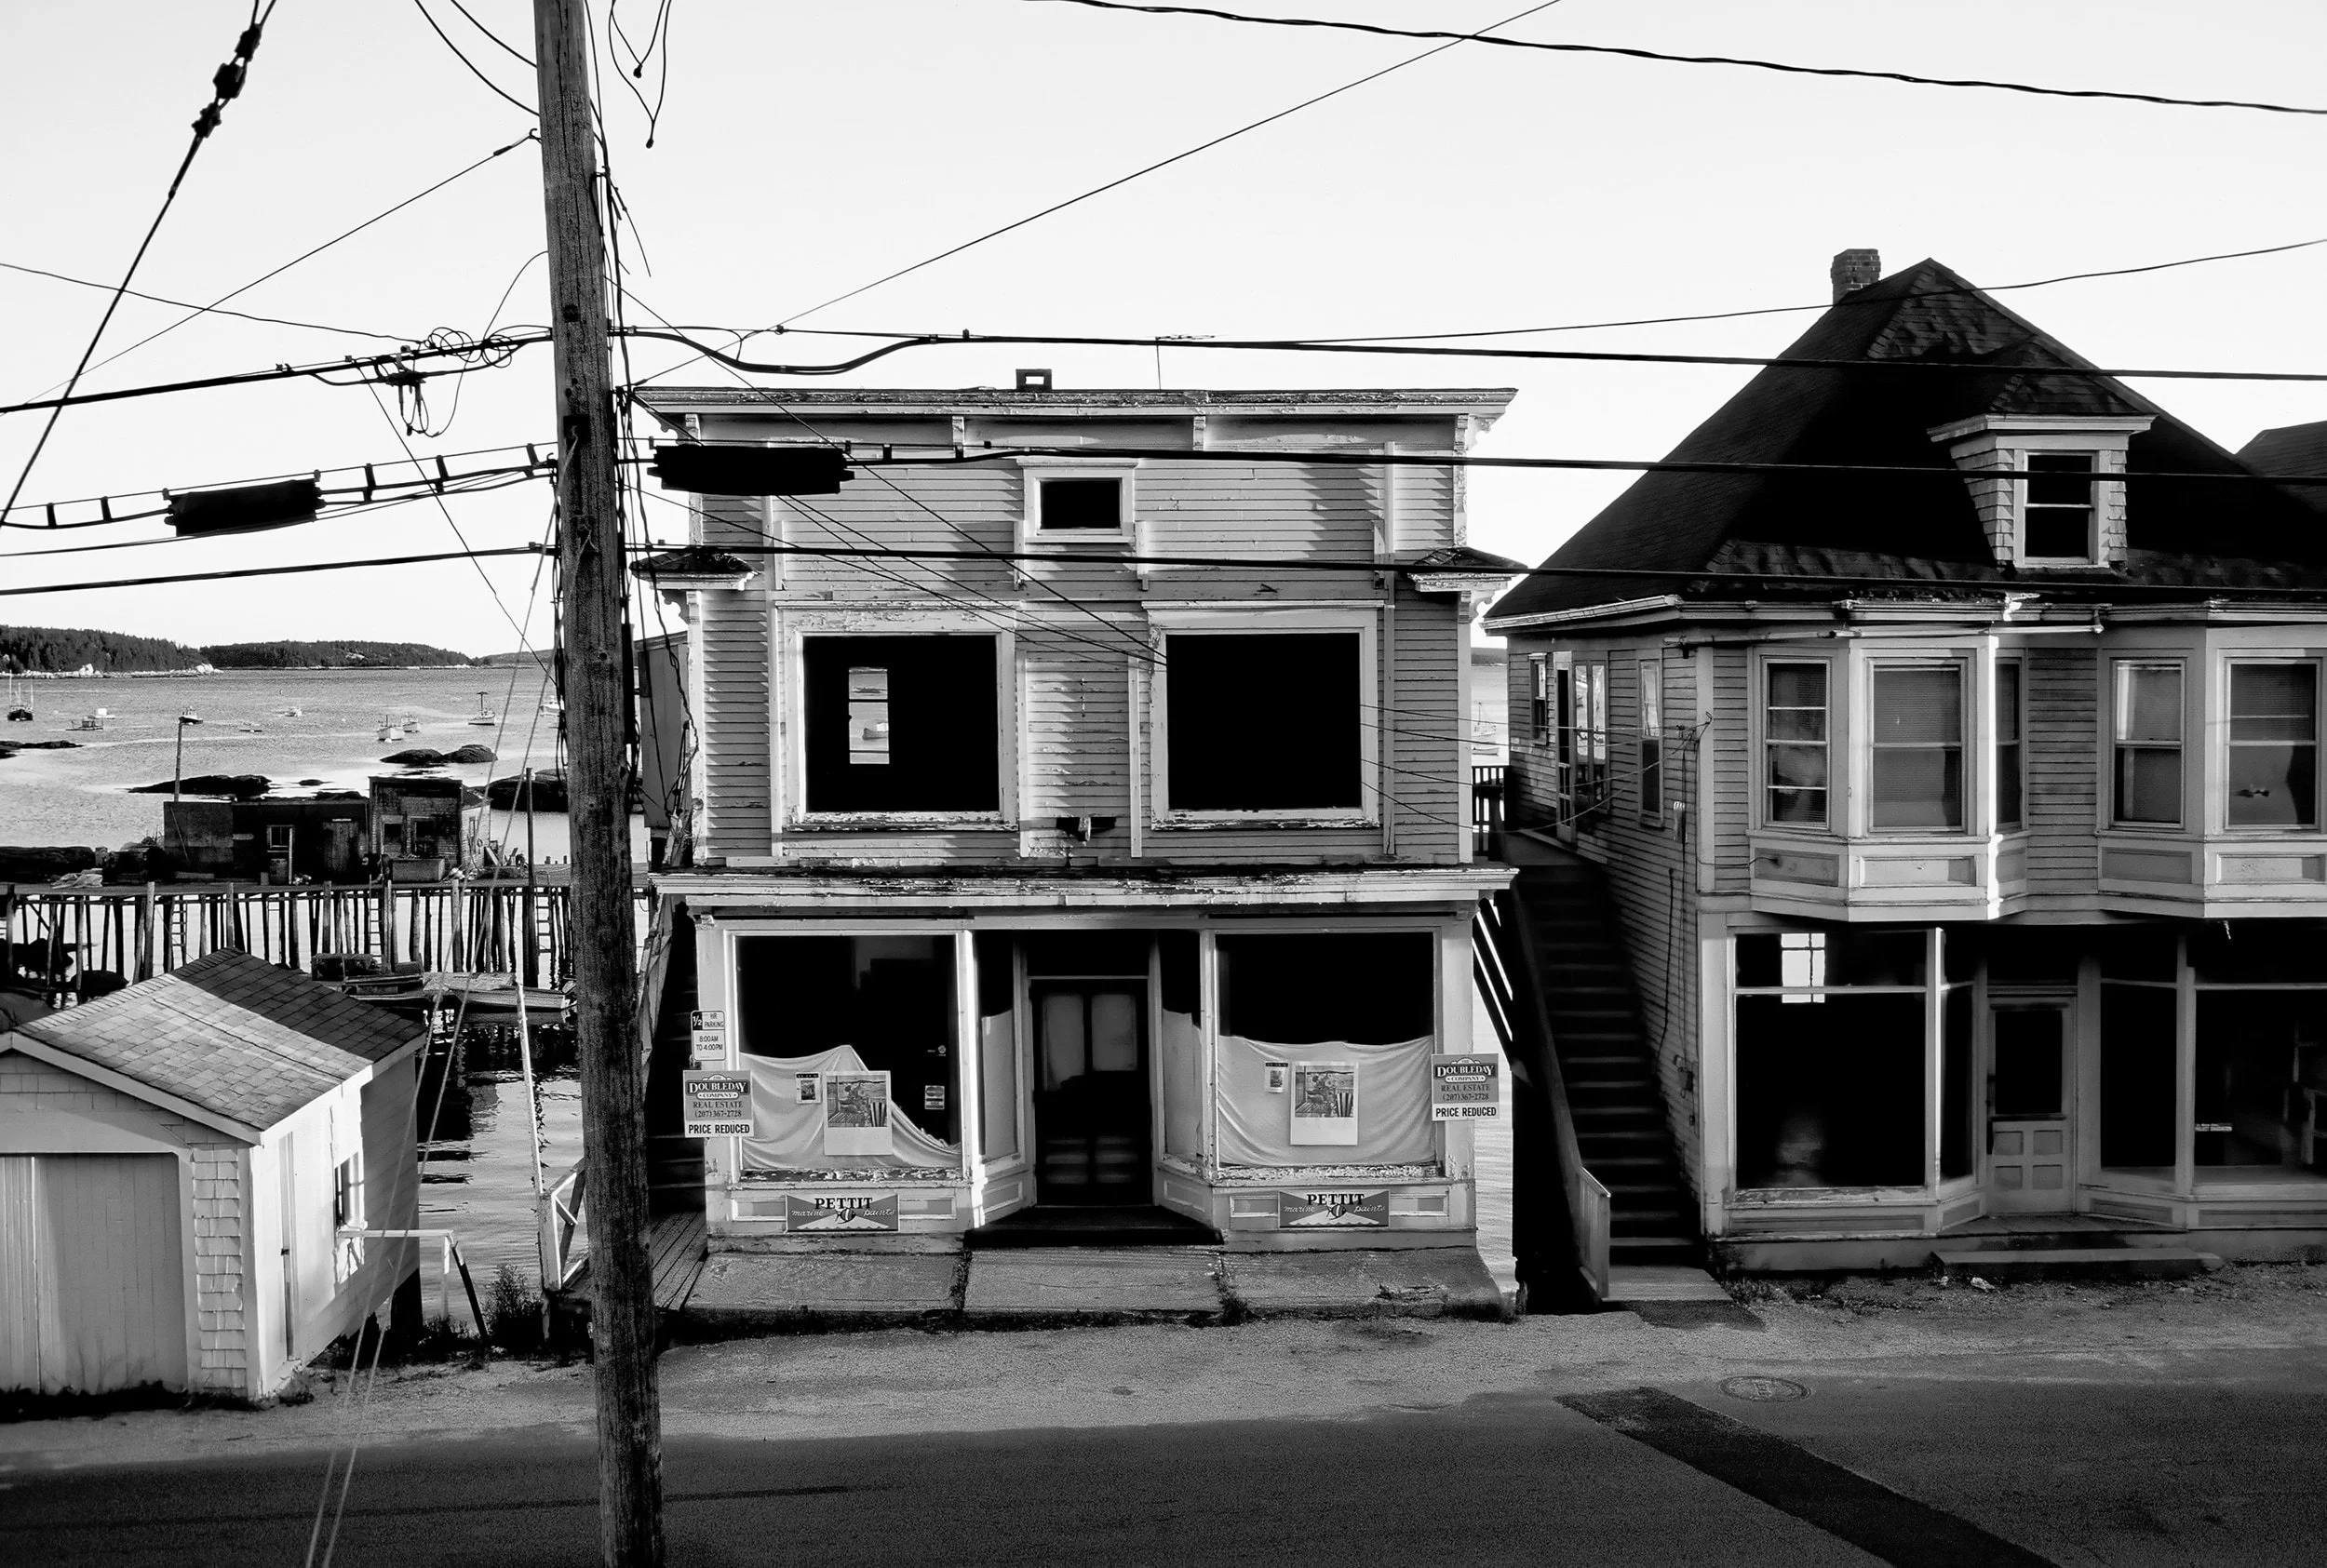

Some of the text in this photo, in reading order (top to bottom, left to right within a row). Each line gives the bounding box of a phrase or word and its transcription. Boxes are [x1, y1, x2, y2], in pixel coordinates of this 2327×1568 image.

[1437, 1065, 1494, 1077] DOUBLEDAY
[689, 1081, 747, 1093] DOUBLEDAY
[715, 1100, 744, 1108] ESTATE
[1436, 1106, 1497, 1118] PRICE REDUCED
[688, 1123, 750, 1134] PRICE REDUCED
[814, 1198, 873, 1209] PETTIT
[1307, 1194, 1365, 1205] PETTIT
[791, 1207, 895, 1217] marine paints
[1284, 1203, 1386, 1213] marine paints
